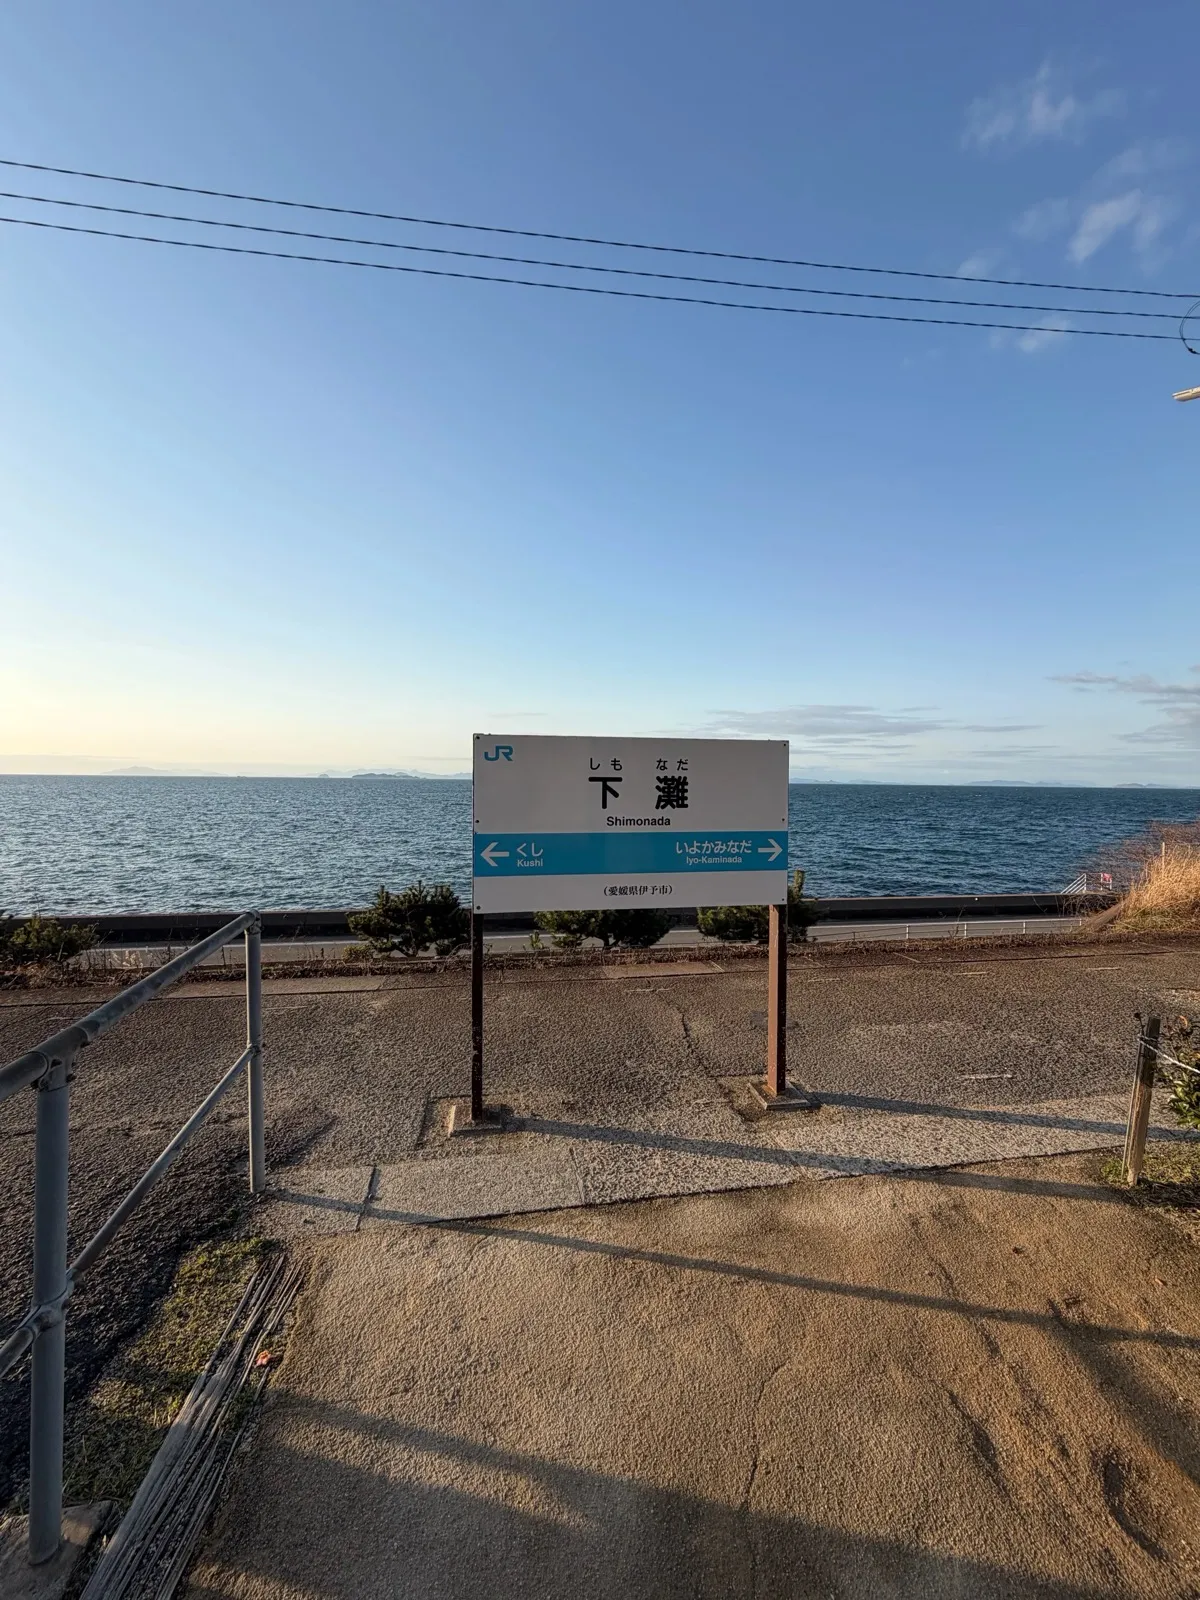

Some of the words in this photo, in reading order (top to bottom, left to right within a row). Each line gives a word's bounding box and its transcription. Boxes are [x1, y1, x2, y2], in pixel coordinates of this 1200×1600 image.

[484, 745, 514, 762] JR
[606, 816, 671, 827] Shimonada
[516, 842, 544, 857] くし
[675, 840, 752, 854] いよかみなだ
[517, 858, 544, 867] Kushi
[686, 855, 743, 866] Iyo-Kaminada
